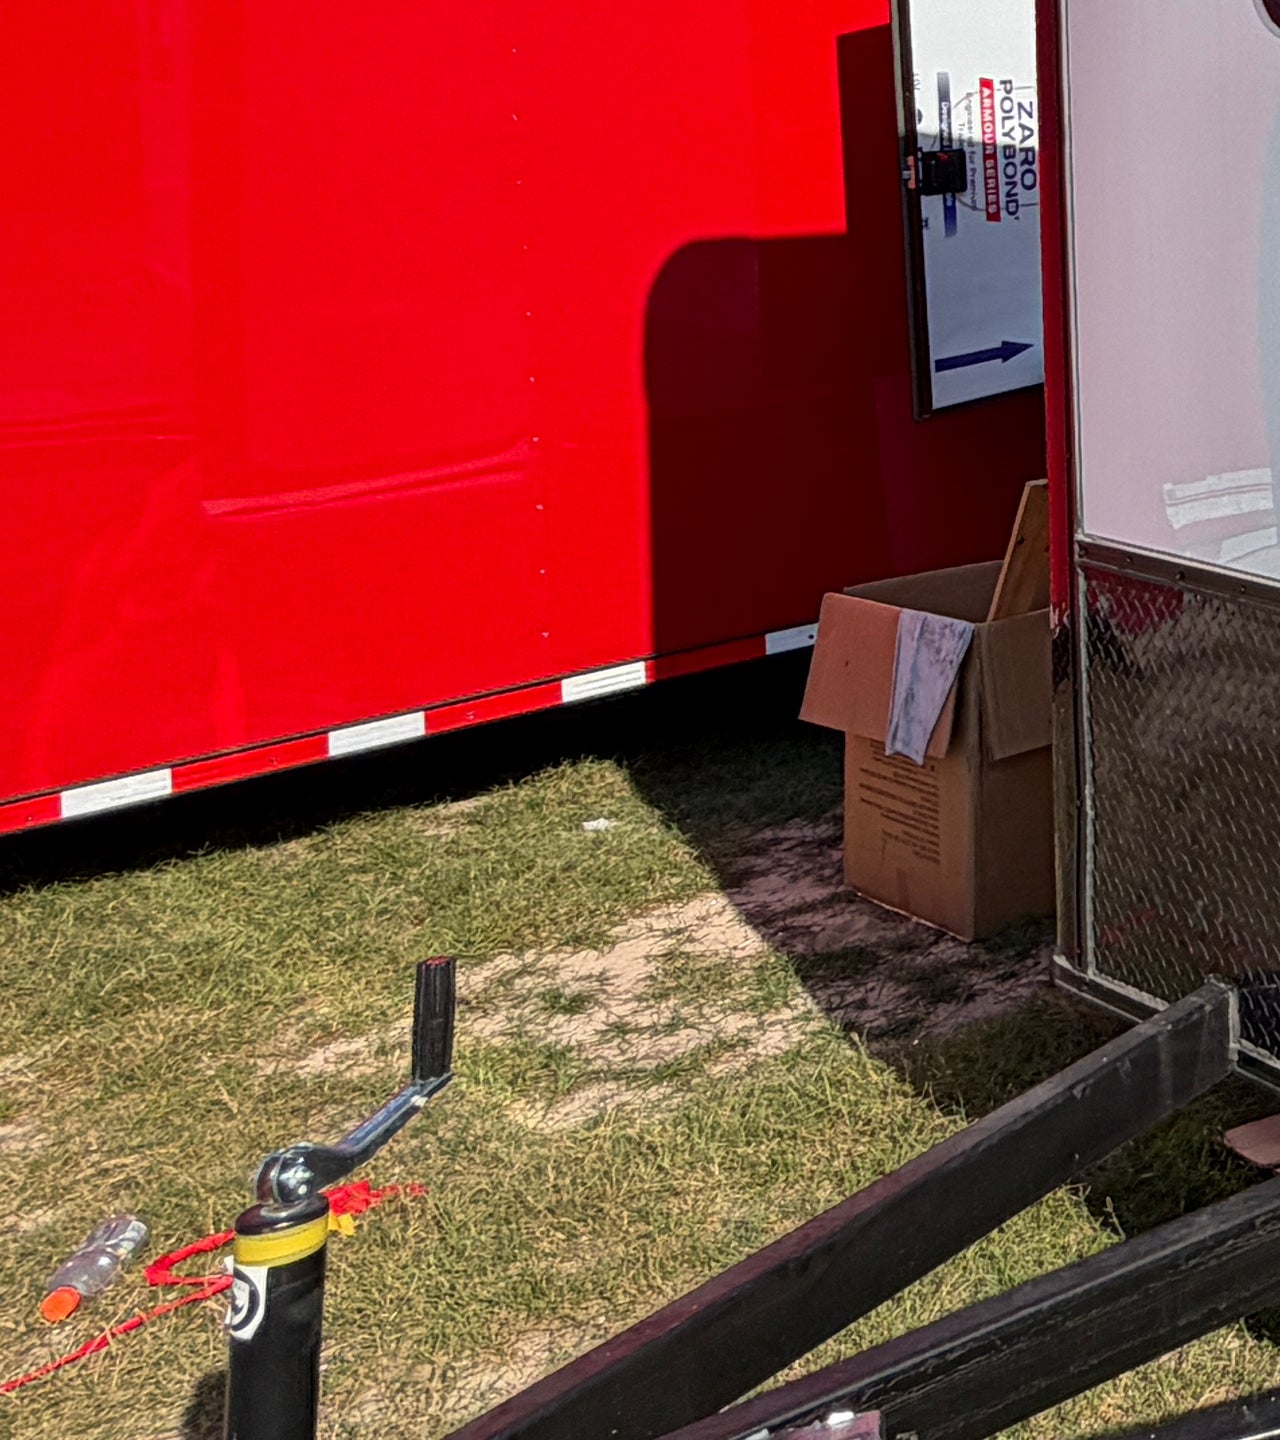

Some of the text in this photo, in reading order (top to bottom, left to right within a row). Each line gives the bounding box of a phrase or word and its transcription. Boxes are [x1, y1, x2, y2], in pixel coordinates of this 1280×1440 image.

[981, 87, 997, 214] ARMOUR SERIES
[1017, 101, 1037, 191] ZARO
